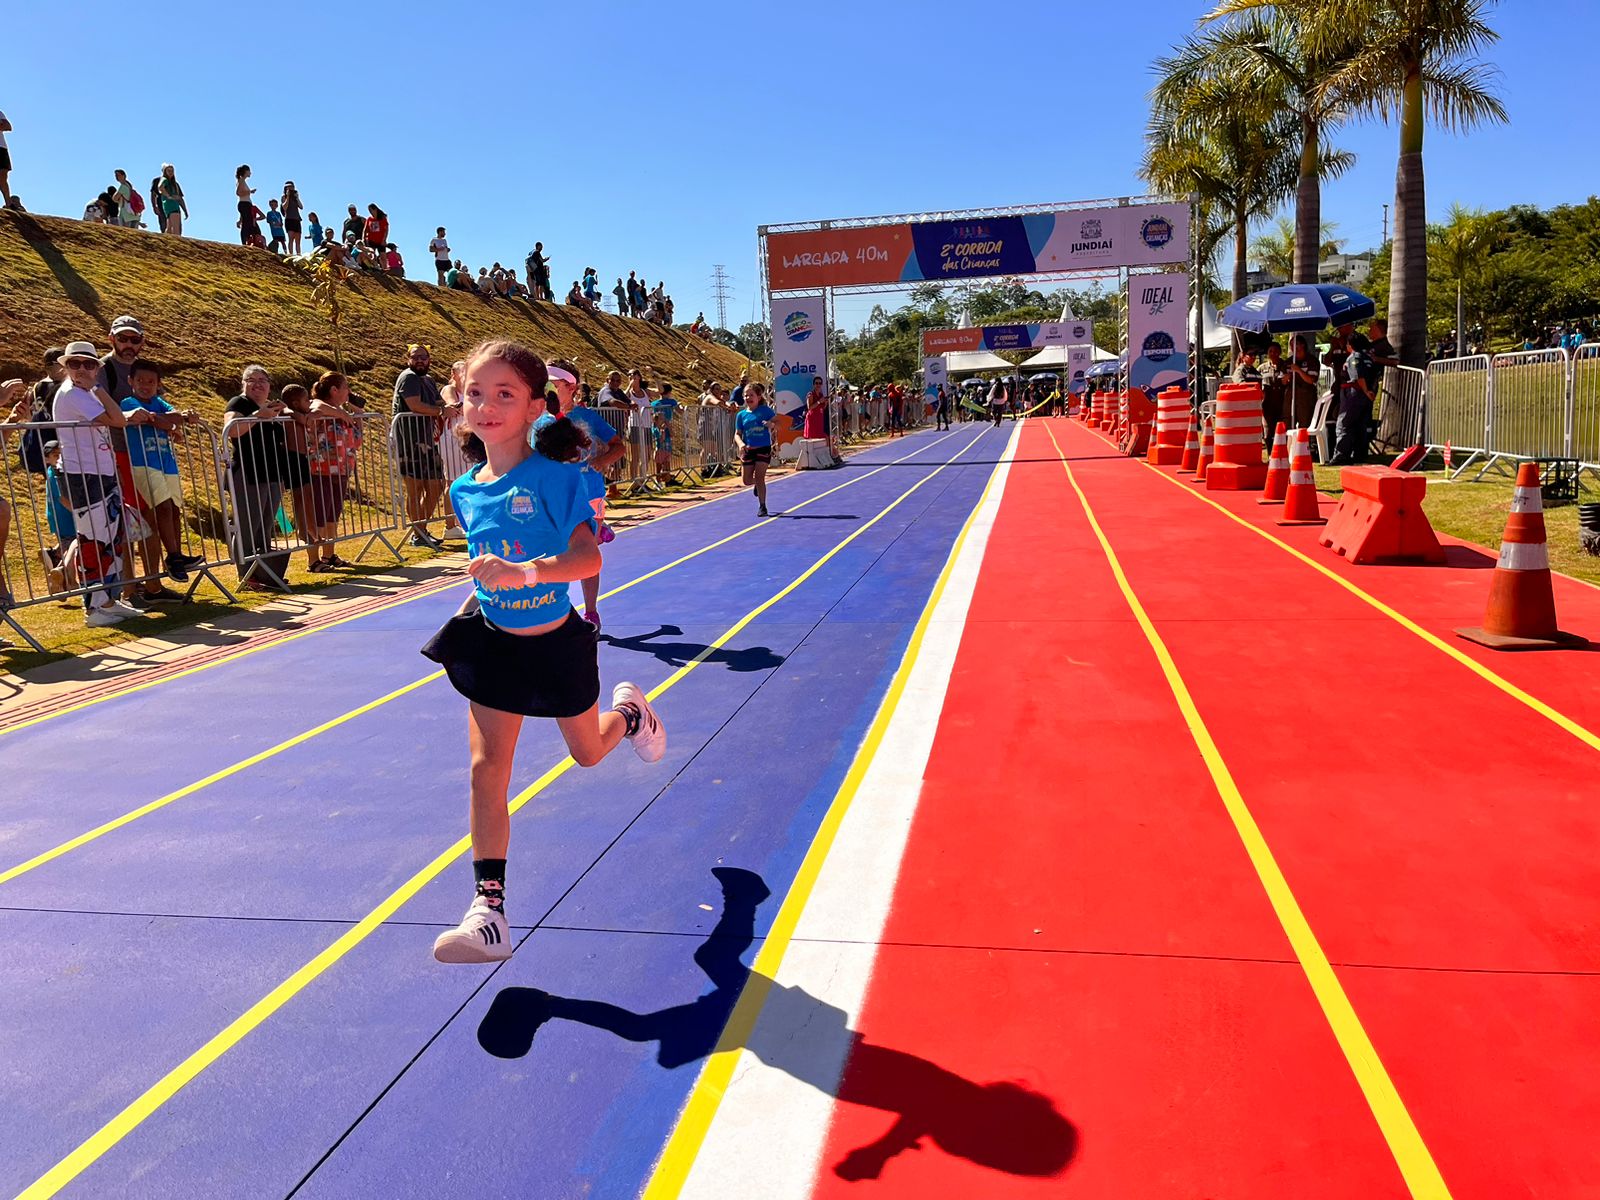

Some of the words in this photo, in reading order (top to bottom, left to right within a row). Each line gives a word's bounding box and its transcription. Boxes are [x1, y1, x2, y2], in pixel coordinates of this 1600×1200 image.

[955, 239, 1003, 257] CORRIDA
[1071, 239, 1112, 253] JUNDIAÍ
[783, 251, 849, 268] LARGADA
[855, 245, 889, 264] 40M
[941, 257, 959, 273] das
[960, 256, 1001, 270] Crianças
[1141, 286, 1174, 305] IDEAL
[1149, 303, 1167, 315] 5K
[1143, 348, 1173, 356] ESPORTE
[792, 362, 816, 373] dae
